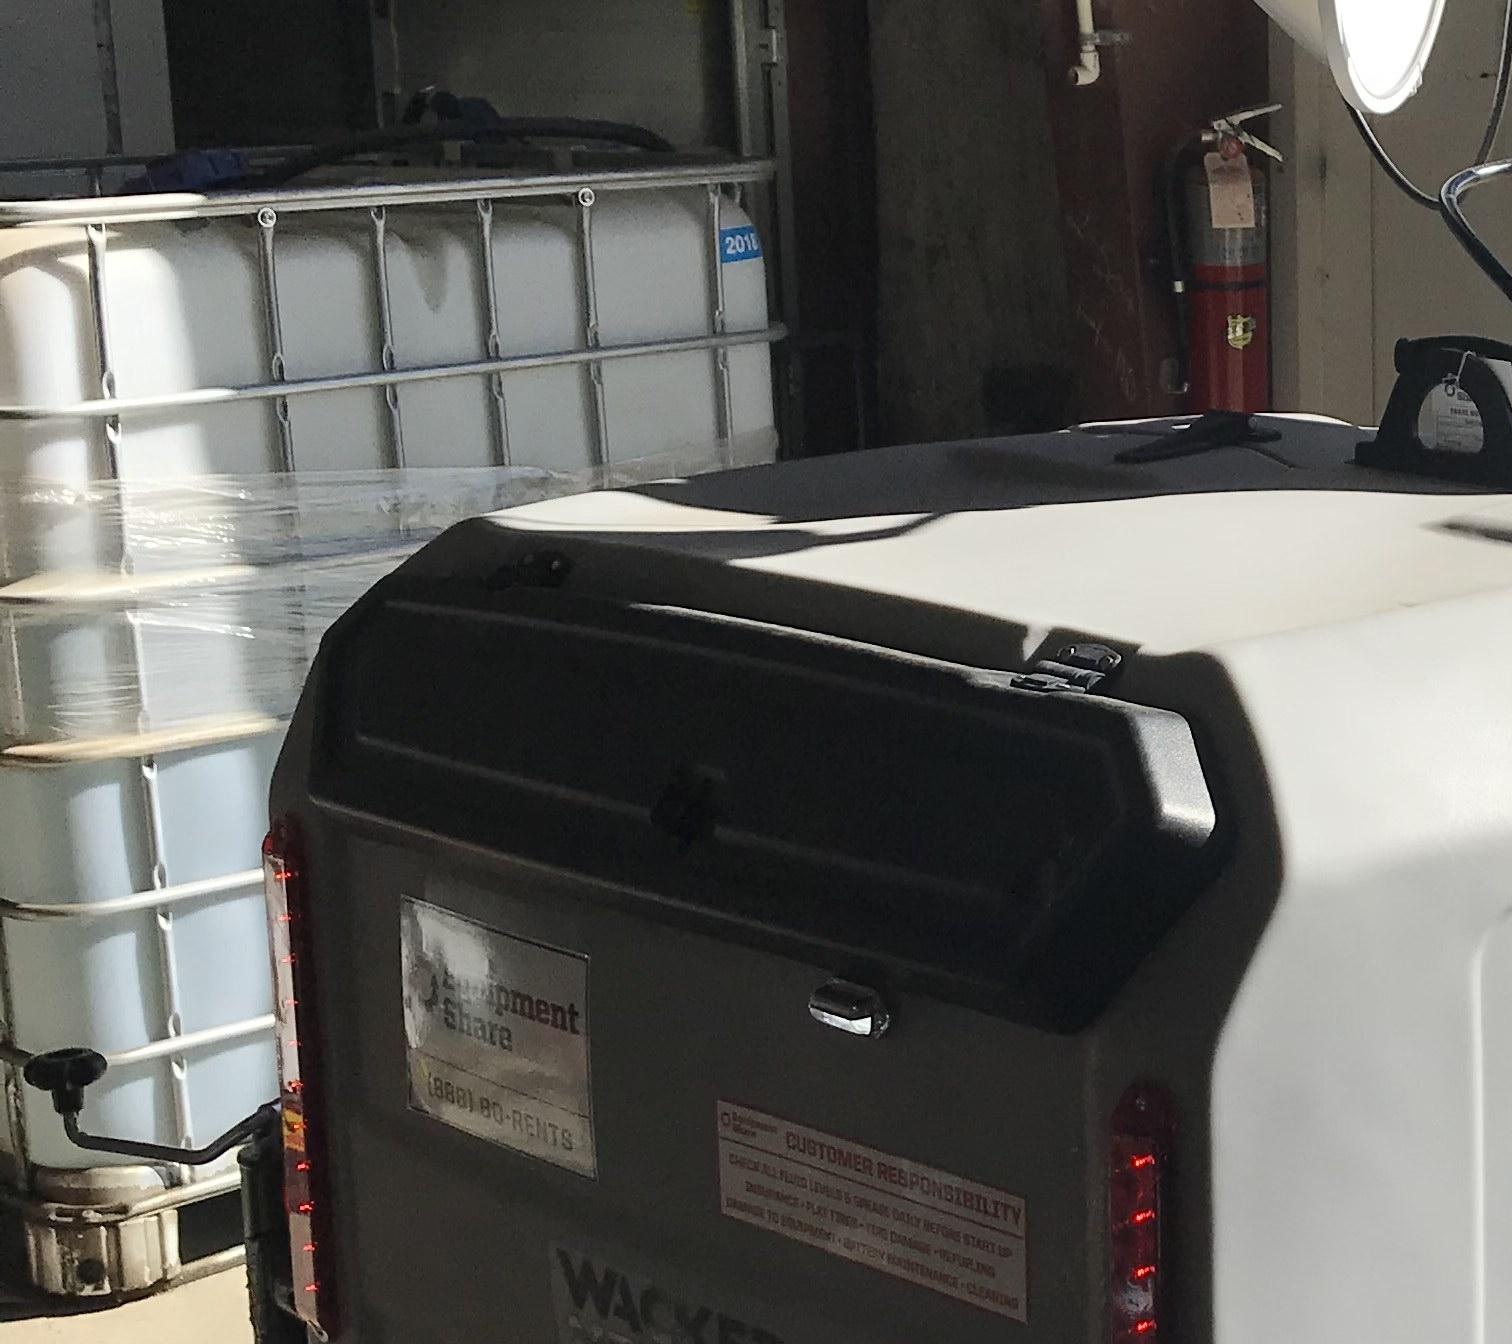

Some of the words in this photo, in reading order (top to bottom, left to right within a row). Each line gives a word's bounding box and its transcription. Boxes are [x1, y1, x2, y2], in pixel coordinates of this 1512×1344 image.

[443, 997, 513, 1052] Share
[428, 1072, 474, 1113] (888)
[479, 1092, 574, 1153] 80-RENTS
[786, 1133, 874, 1178] CUSTOMER
[877, 1164, 1021, 1226] RESPONSIBILITY
